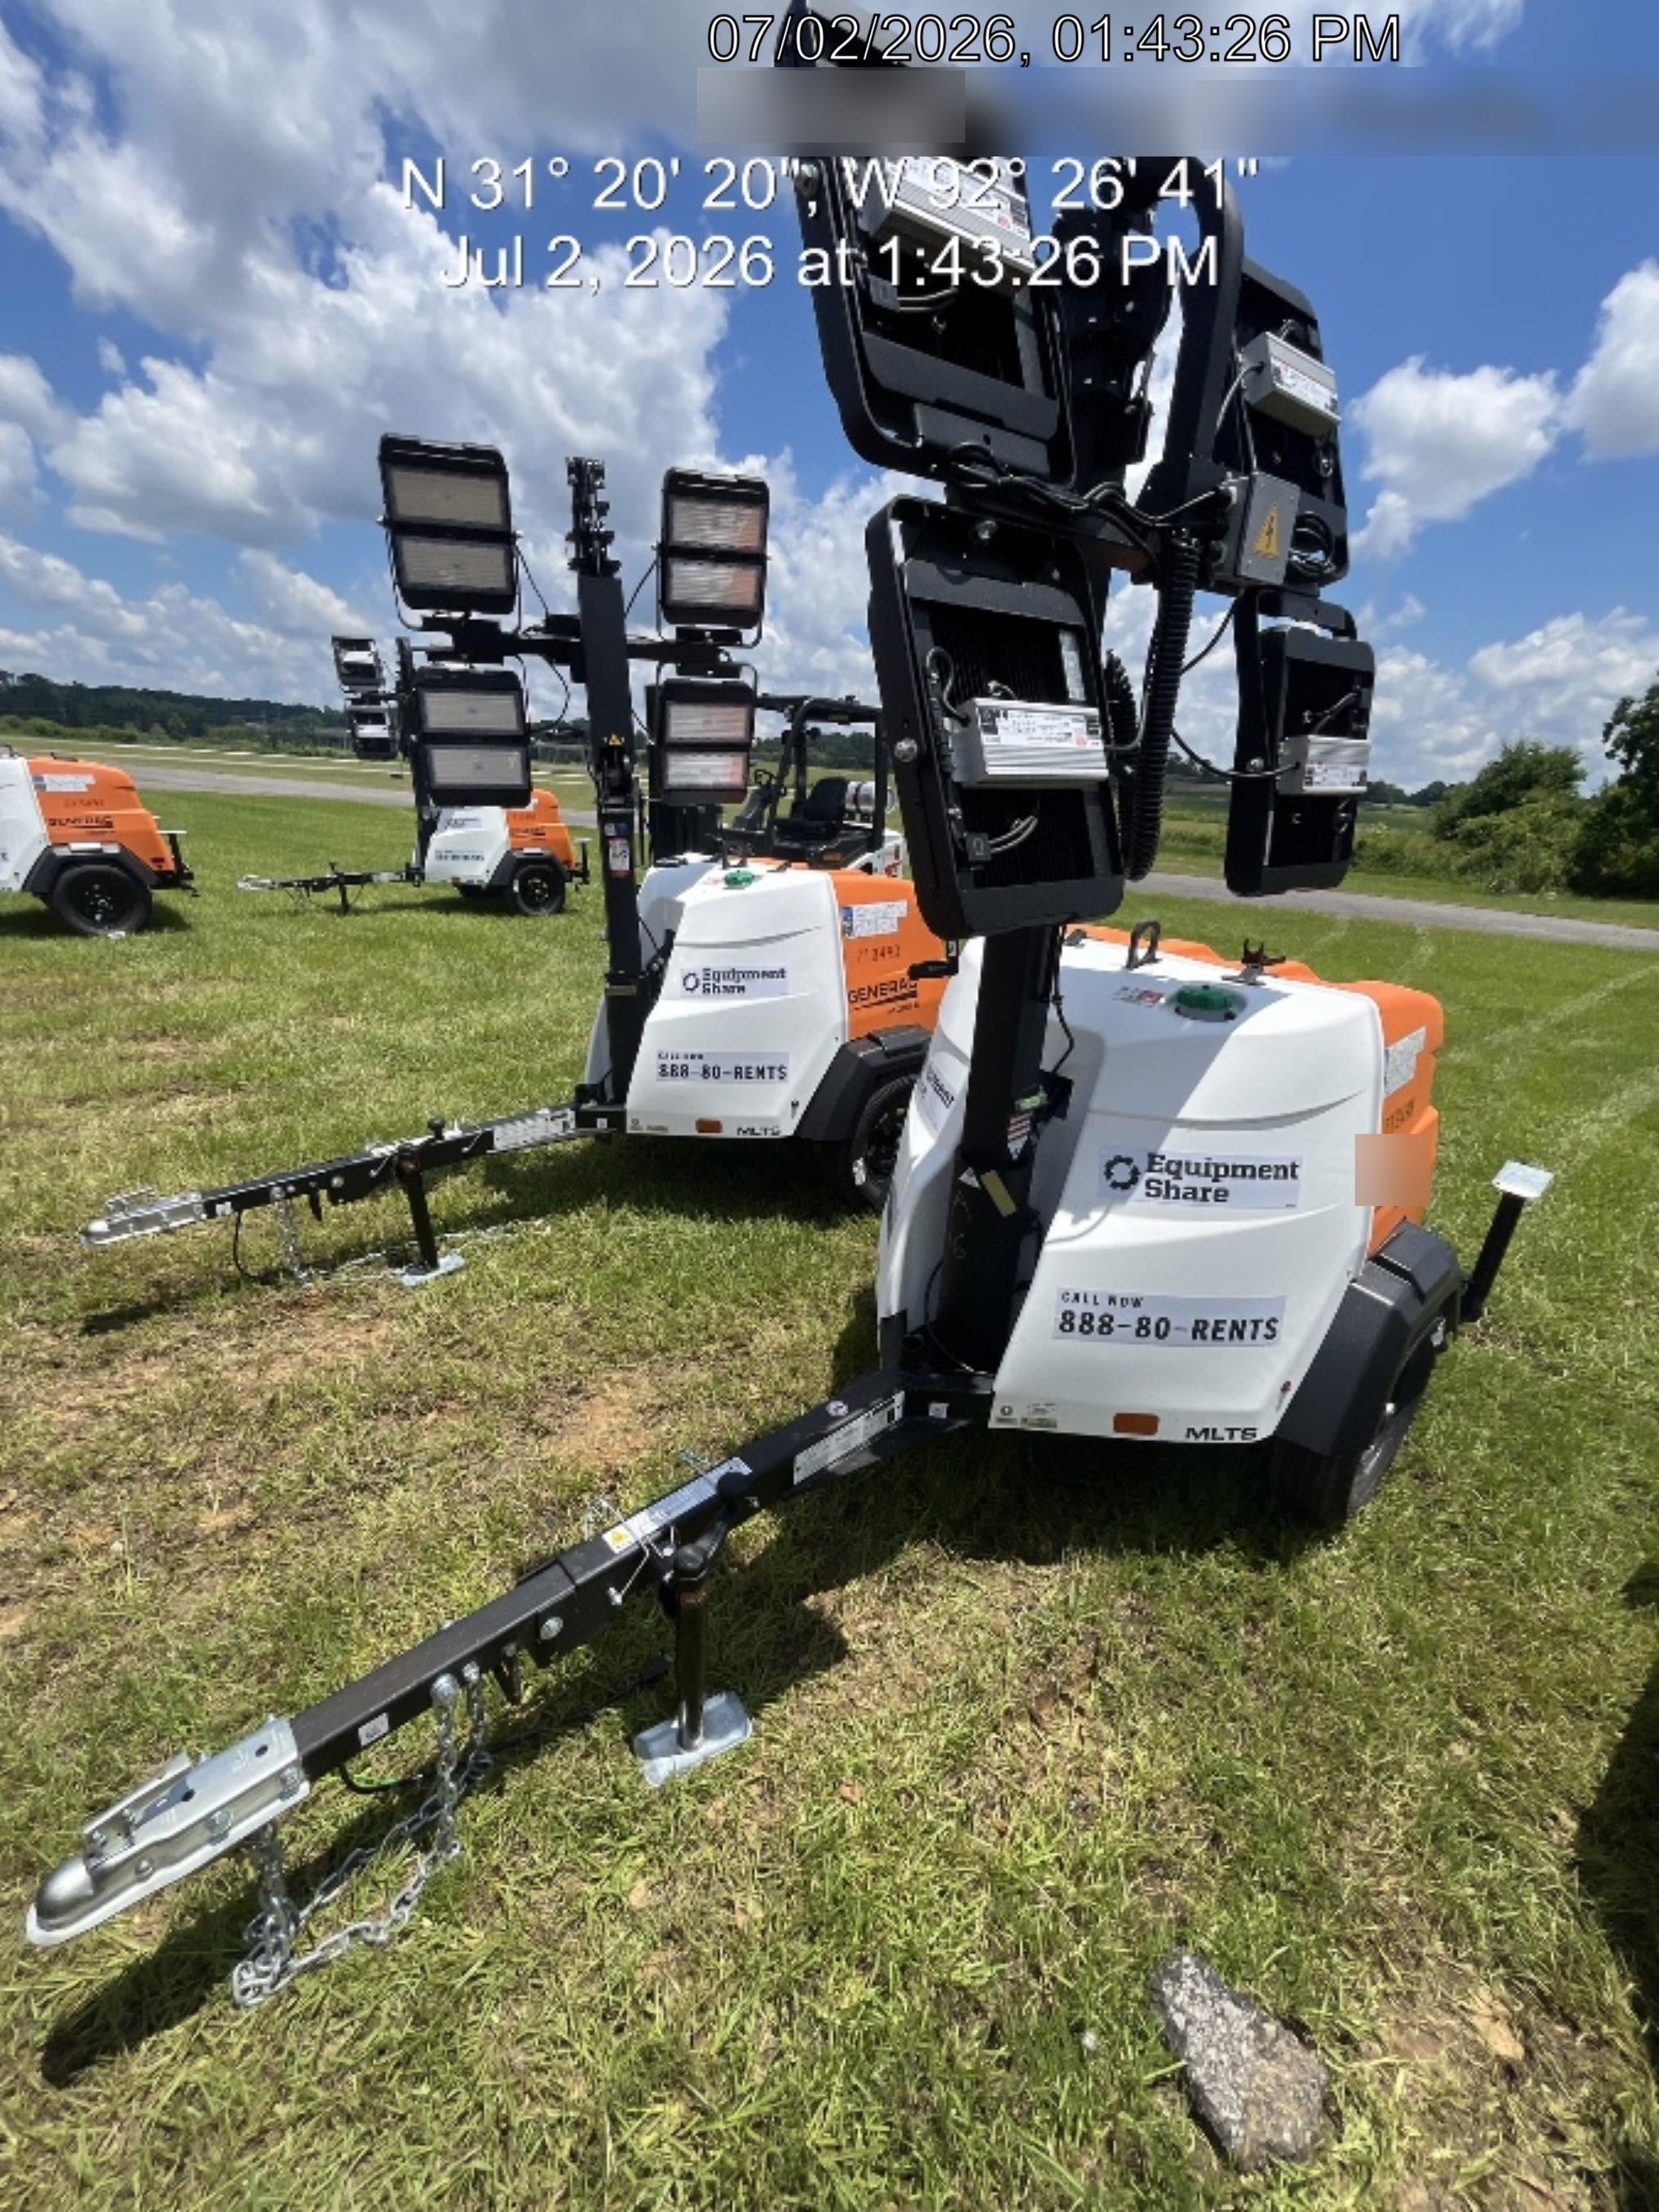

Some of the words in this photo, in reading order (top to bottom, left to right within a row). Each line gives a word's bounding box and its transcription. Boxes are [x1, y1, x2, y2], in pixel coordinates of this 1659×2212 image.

[1145, 1152, 1300, 1183] Equipment
[1144, 1177, 1231, 1203] Share
[1061, 1291, 1100, 1306] CALL
[1108, 1294, 1144, 1309] NOW
[1058, 1309, 1281, 1342] 888-80-RENTS
